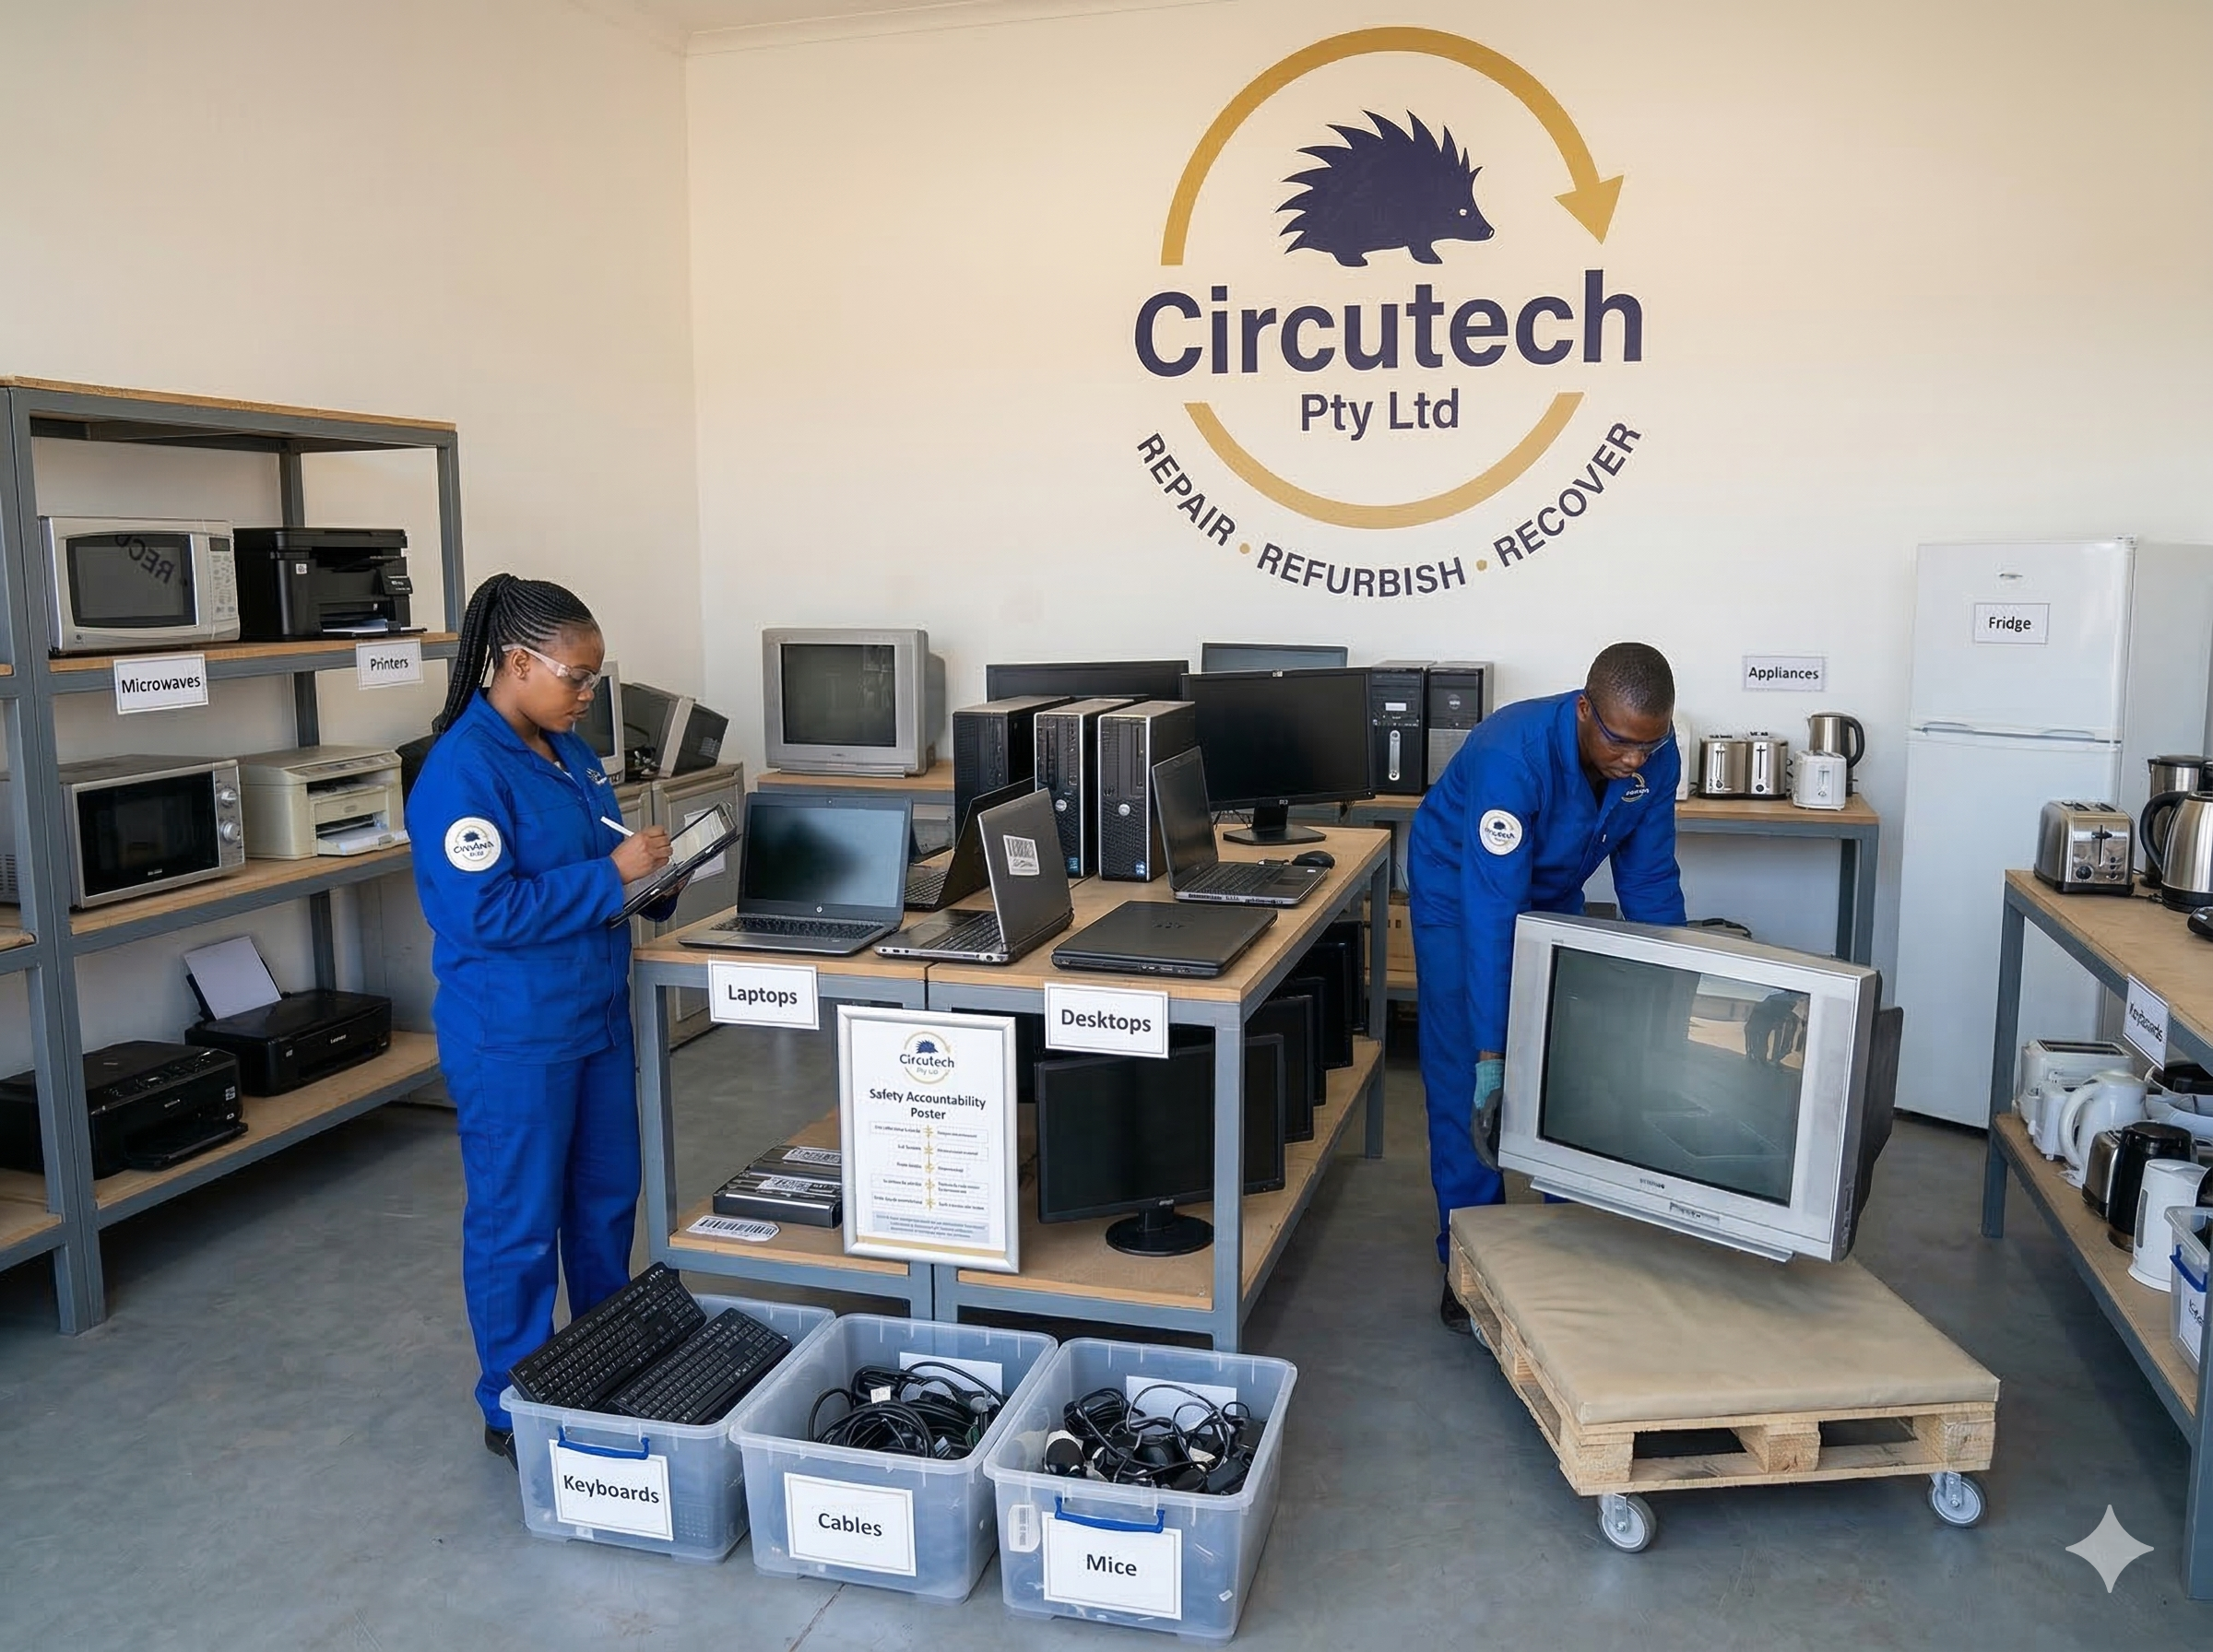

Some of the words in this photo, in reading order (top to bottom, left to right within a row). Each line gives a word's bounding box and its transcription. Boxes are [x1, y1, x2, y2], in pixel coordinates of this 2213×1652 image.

[1135, 269, 1642, 377] Circutech
[1301, 394, 1374, 442] Pty
[1390, 388, 1459, 430] Ltd
[1137, 432, 1236, 547] REPAIR
[1256, 542, 1466, 597] REFURBISH
[1493, 422, 1641, 568] RECOVER
[1989, 616, 2032, 633] Fridge
[370, 656, 409, 672] Printers
[1748, 666, 1819, 681] Appliances
[122, 675, 201, 695] Microwaves
[728, 984, 798, 1008] Laptops
[1061, 1009, 1152, 1035] Desktops
[899, 1053, 955, 1068] Circutech
[870, 1088, 904, 1103] Safety
[905, 1091, 987, 1111] Accountability
[910, 1107, 947, 1120] Poster
[563, 1474, 659, 1504] Keyboards
[818, 1513, 882, 1537] Cables
[1086, 1553, 1137, 1576] Mice
